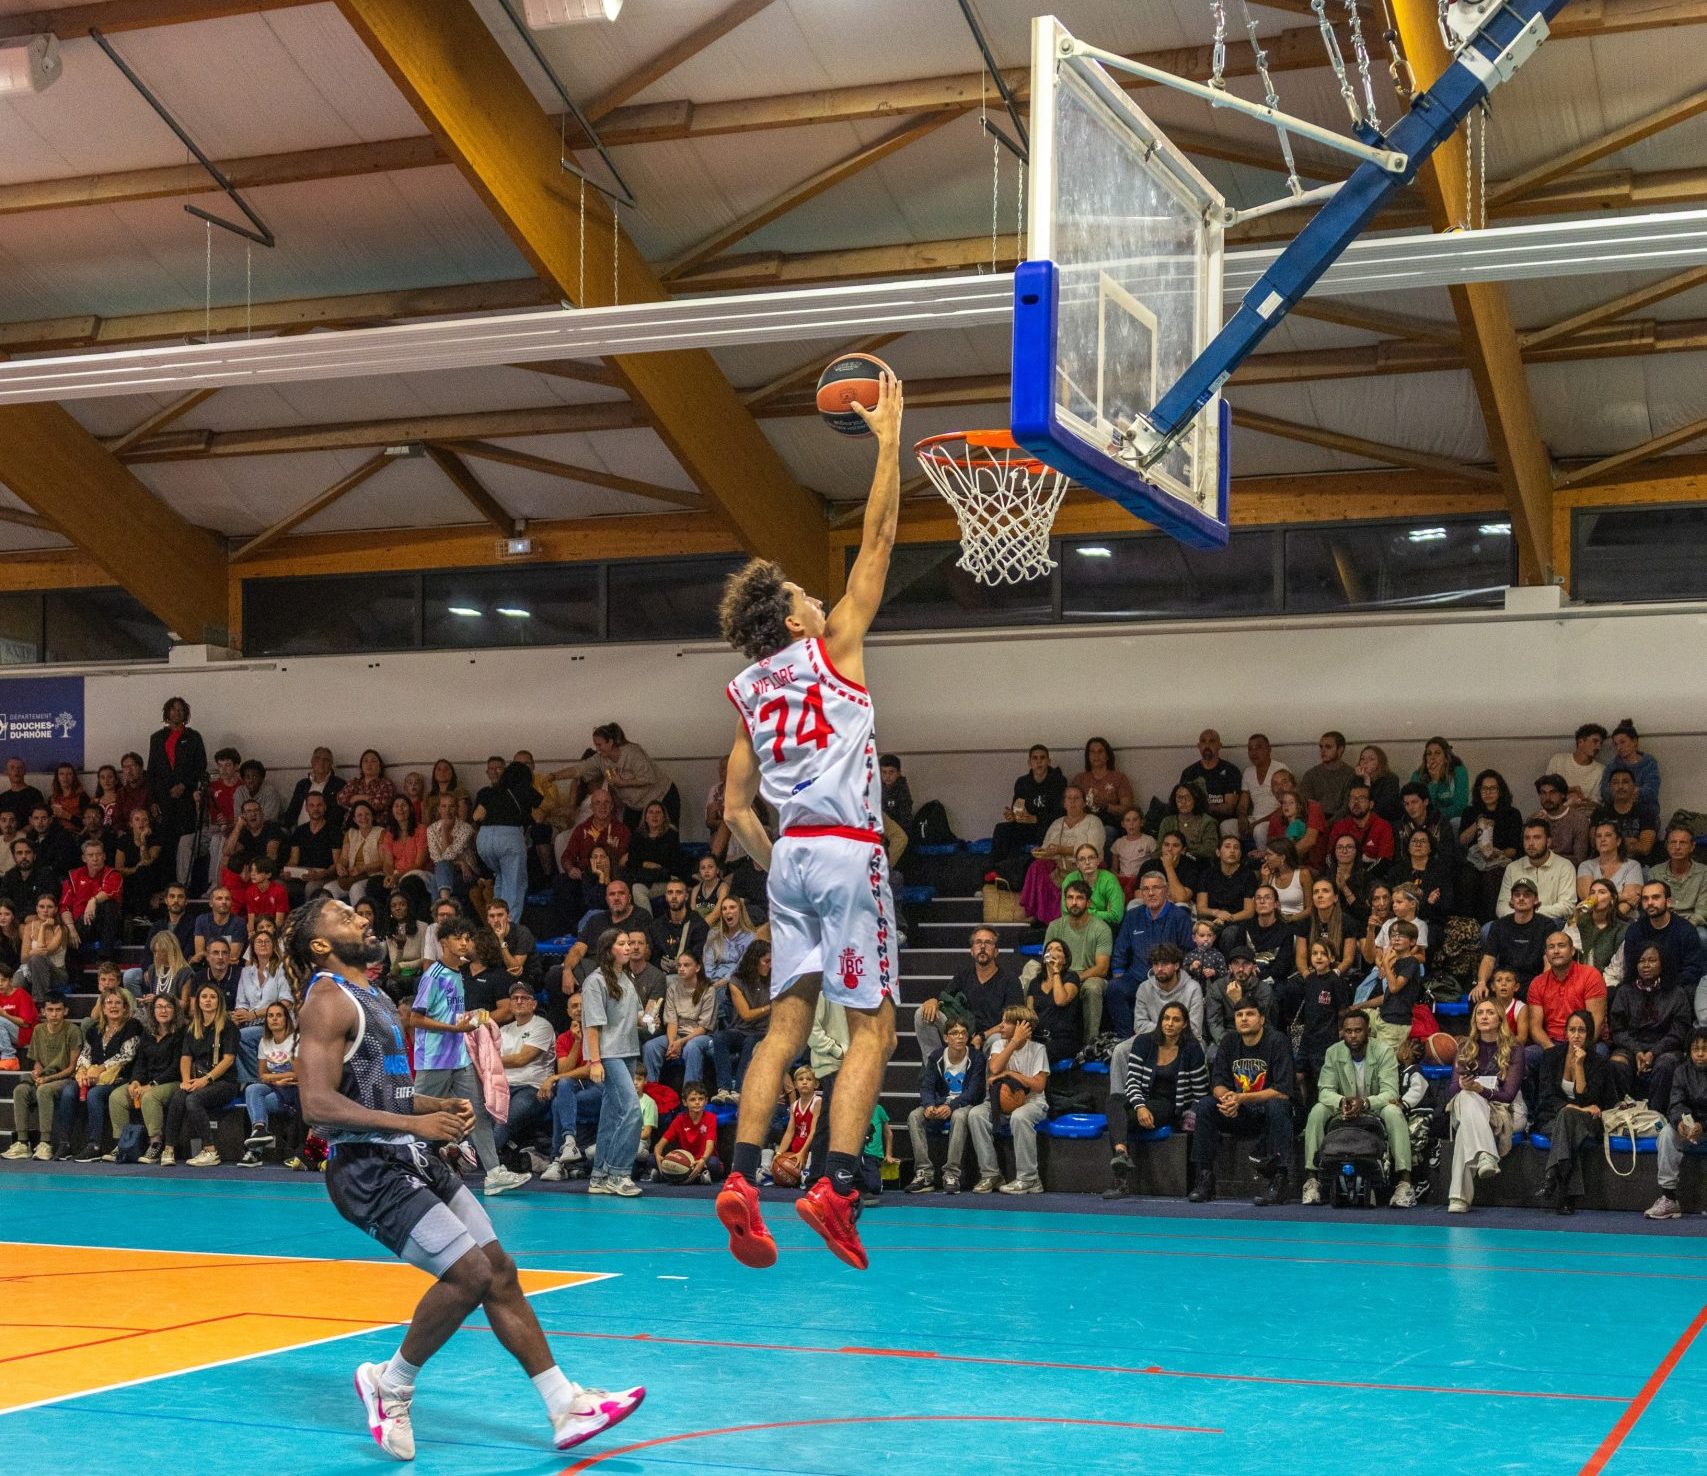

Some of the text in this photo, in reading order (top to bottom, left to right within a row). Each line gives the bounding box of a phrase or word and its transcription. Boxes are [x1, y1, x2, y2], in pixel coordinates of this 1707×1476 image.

[9, 712, 52, 721] DÉPARTEMENT
[759, 683, 835, 764] 74
[10, 729, 52, 739] DU-RHÔNE
[840, 957, 863, 975] VBC
